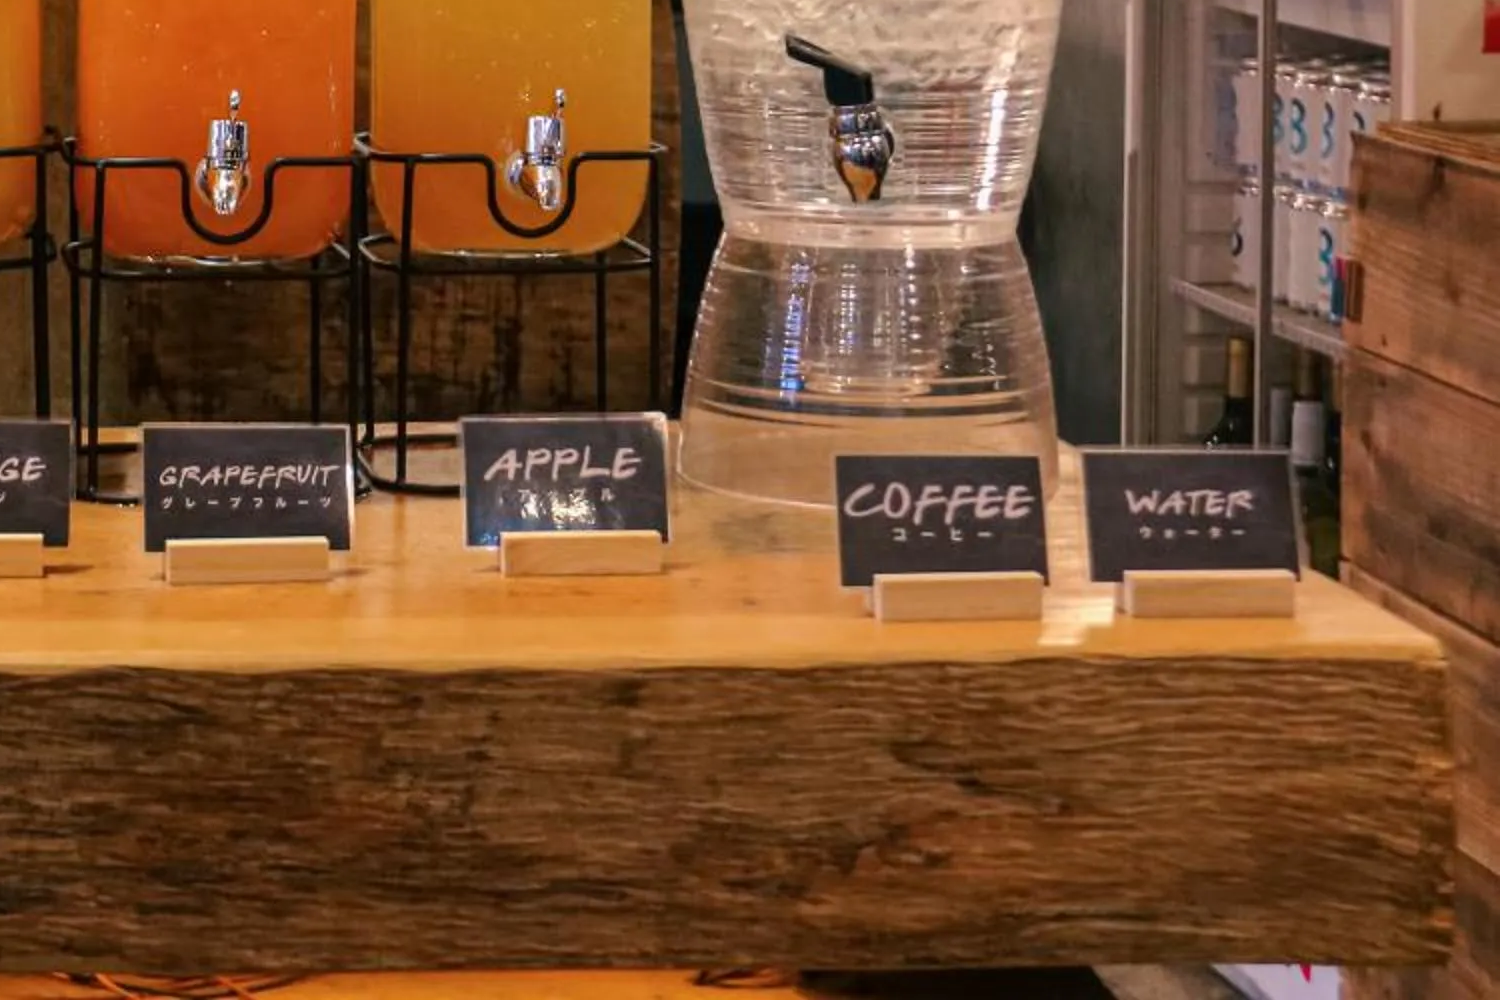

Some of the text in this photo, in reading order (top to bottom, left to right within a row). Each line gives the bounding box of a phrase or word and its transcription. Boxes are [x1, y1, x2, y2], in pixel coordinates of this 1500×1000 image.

[159, 463, 340, 489] GRAPEFRUIT
[484, 446, 642, 481] APPLE
[843, 481, 1035, 525] COFFEE
[1124, 489, 1255, 519] WATER
[892, 526, 994, 542] コーヒー
